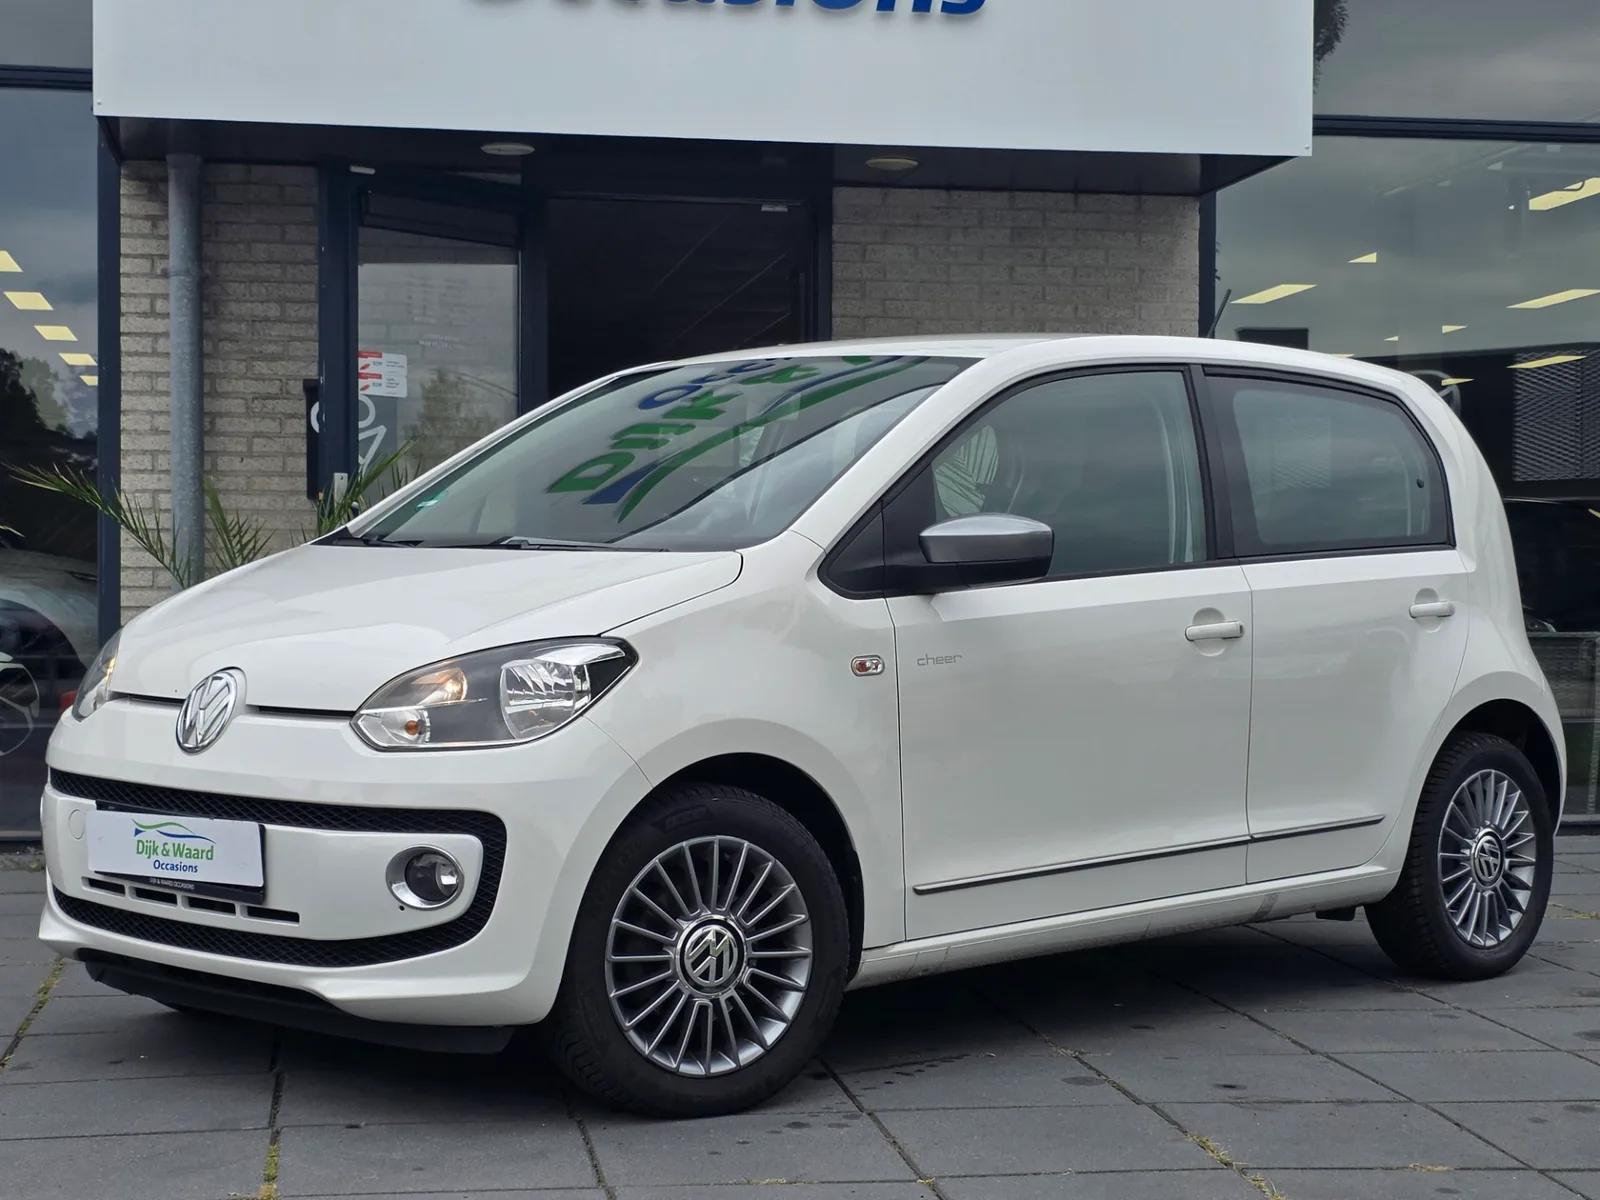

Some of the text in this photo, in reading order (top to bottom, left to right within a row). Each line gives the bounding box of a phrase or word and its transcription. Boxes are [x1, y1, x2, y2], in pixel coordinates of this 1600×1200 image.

[916, 653, 963, 667] cheer
[137, 840, 214, 860] Dijk & Waard
[153, 860, 198, 873] Occasions
